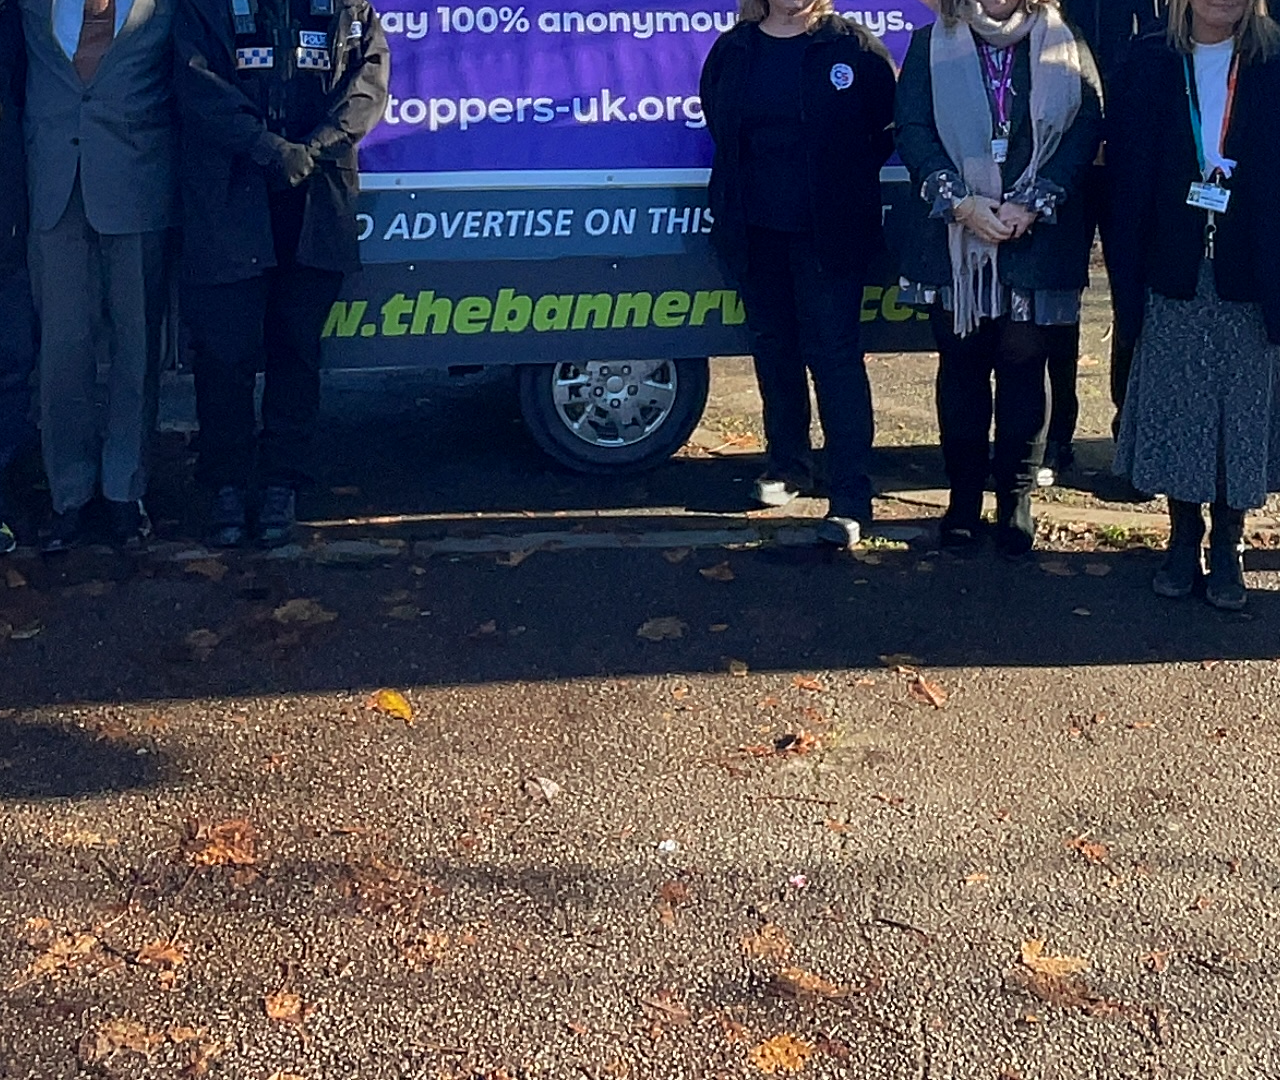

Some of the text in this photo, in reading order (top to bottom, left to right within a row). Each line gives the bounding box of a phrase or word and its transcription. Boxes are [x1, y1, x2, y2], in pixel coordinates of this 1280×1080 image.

[376, 10, 428, 40] ay
[436, 6, 531, 35] 100%
[537, 10, 740, 39] anonymou
[384, 87, 707, 132] toppers-uk.org
[382, 208, 574, 241] ADVERTISE
[583, 207, 637, 236] ON
[647, 206, 715, 235] THIS
